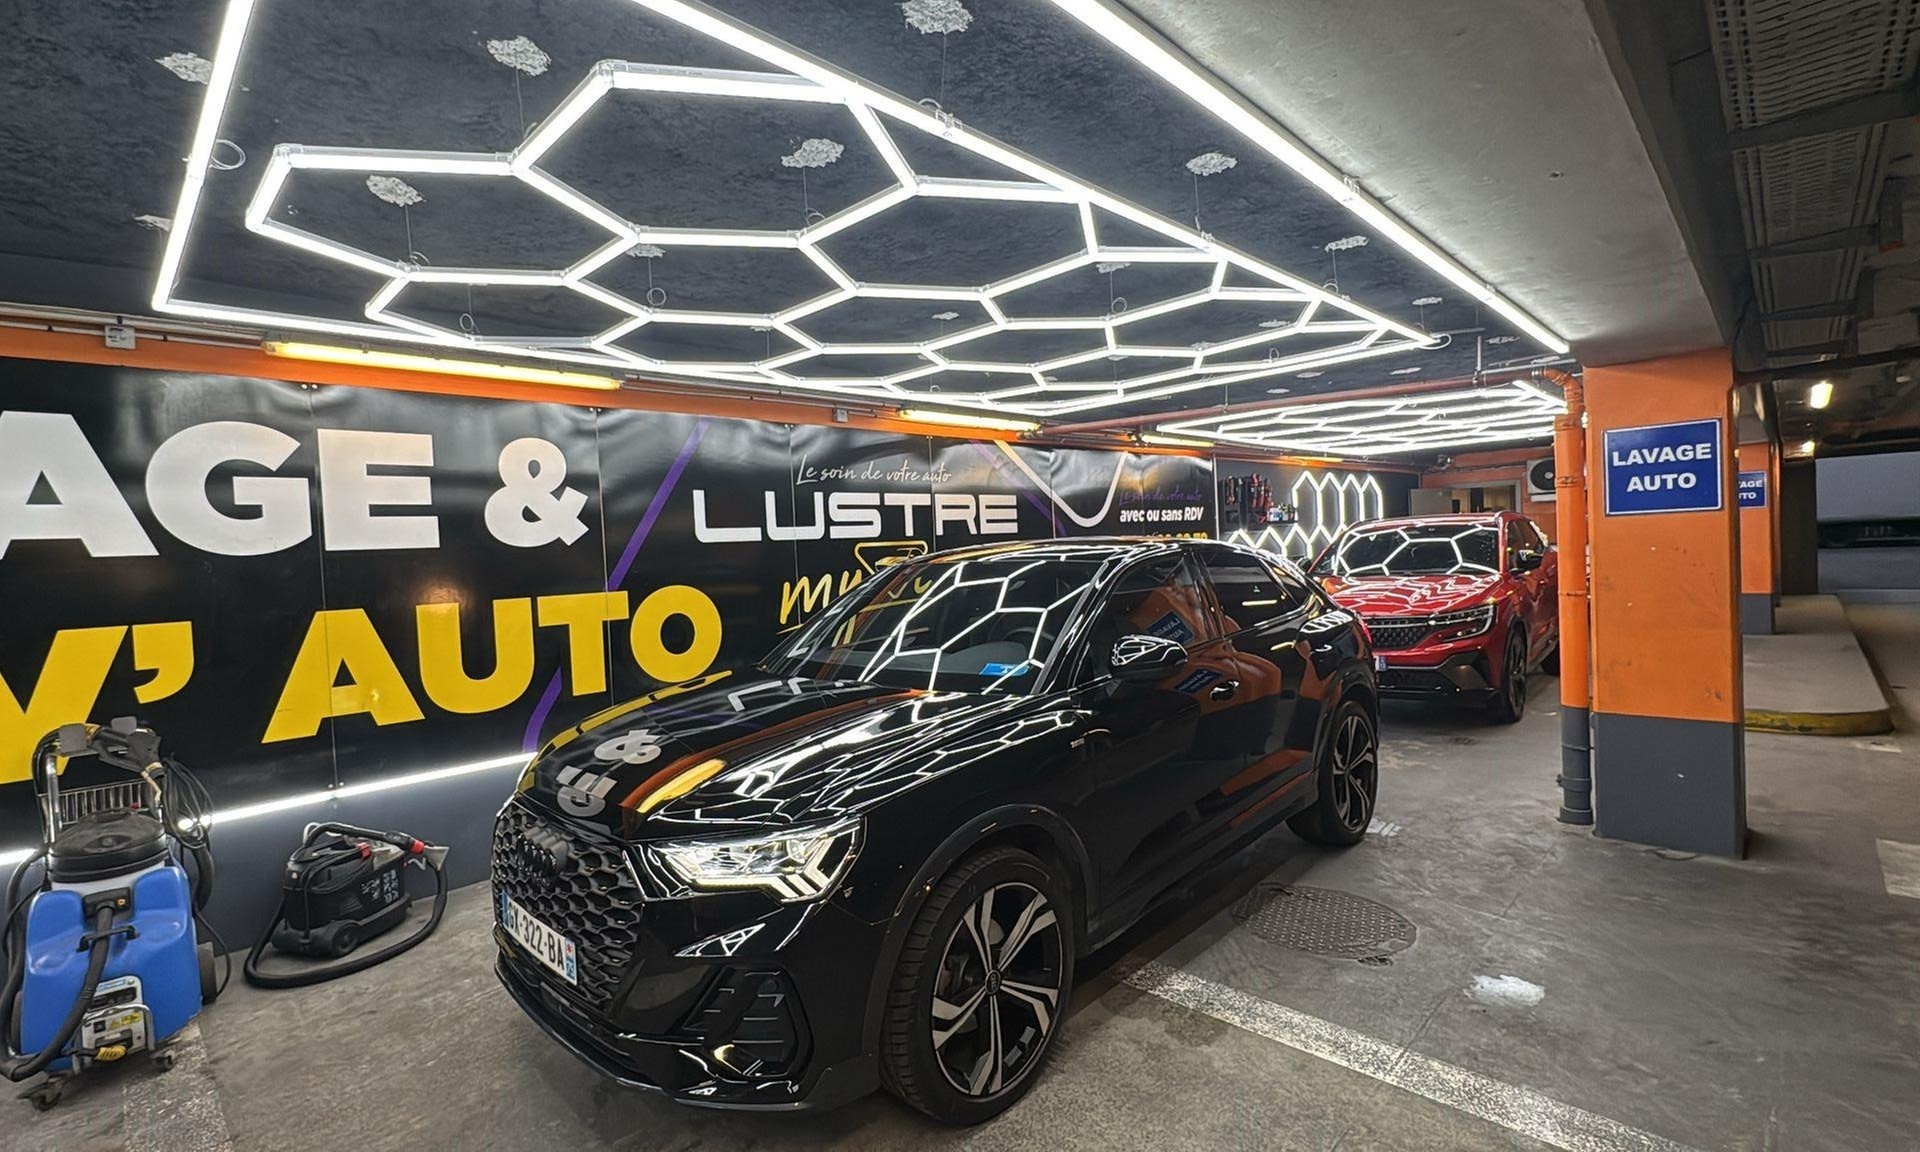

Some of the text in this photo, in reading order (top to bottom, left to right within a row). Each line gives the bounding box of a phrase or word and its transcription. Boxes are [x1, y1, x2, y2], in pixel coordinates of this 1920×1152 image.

[1612, 443, 1712, 467] LAVAGE
[796, 454, 952, 485] Le soin de votre auto
[1626, 472, 1697, 493] AUTO
[0, 410, 590, 557] AGE &
[1738, 480, 1763, 488] AGE
[692, 489, 1018, 543] LUSTRE
[1120, 506, 1204, 522] avec ou sans RDV
[261, 585, 722, 743] AUTO
